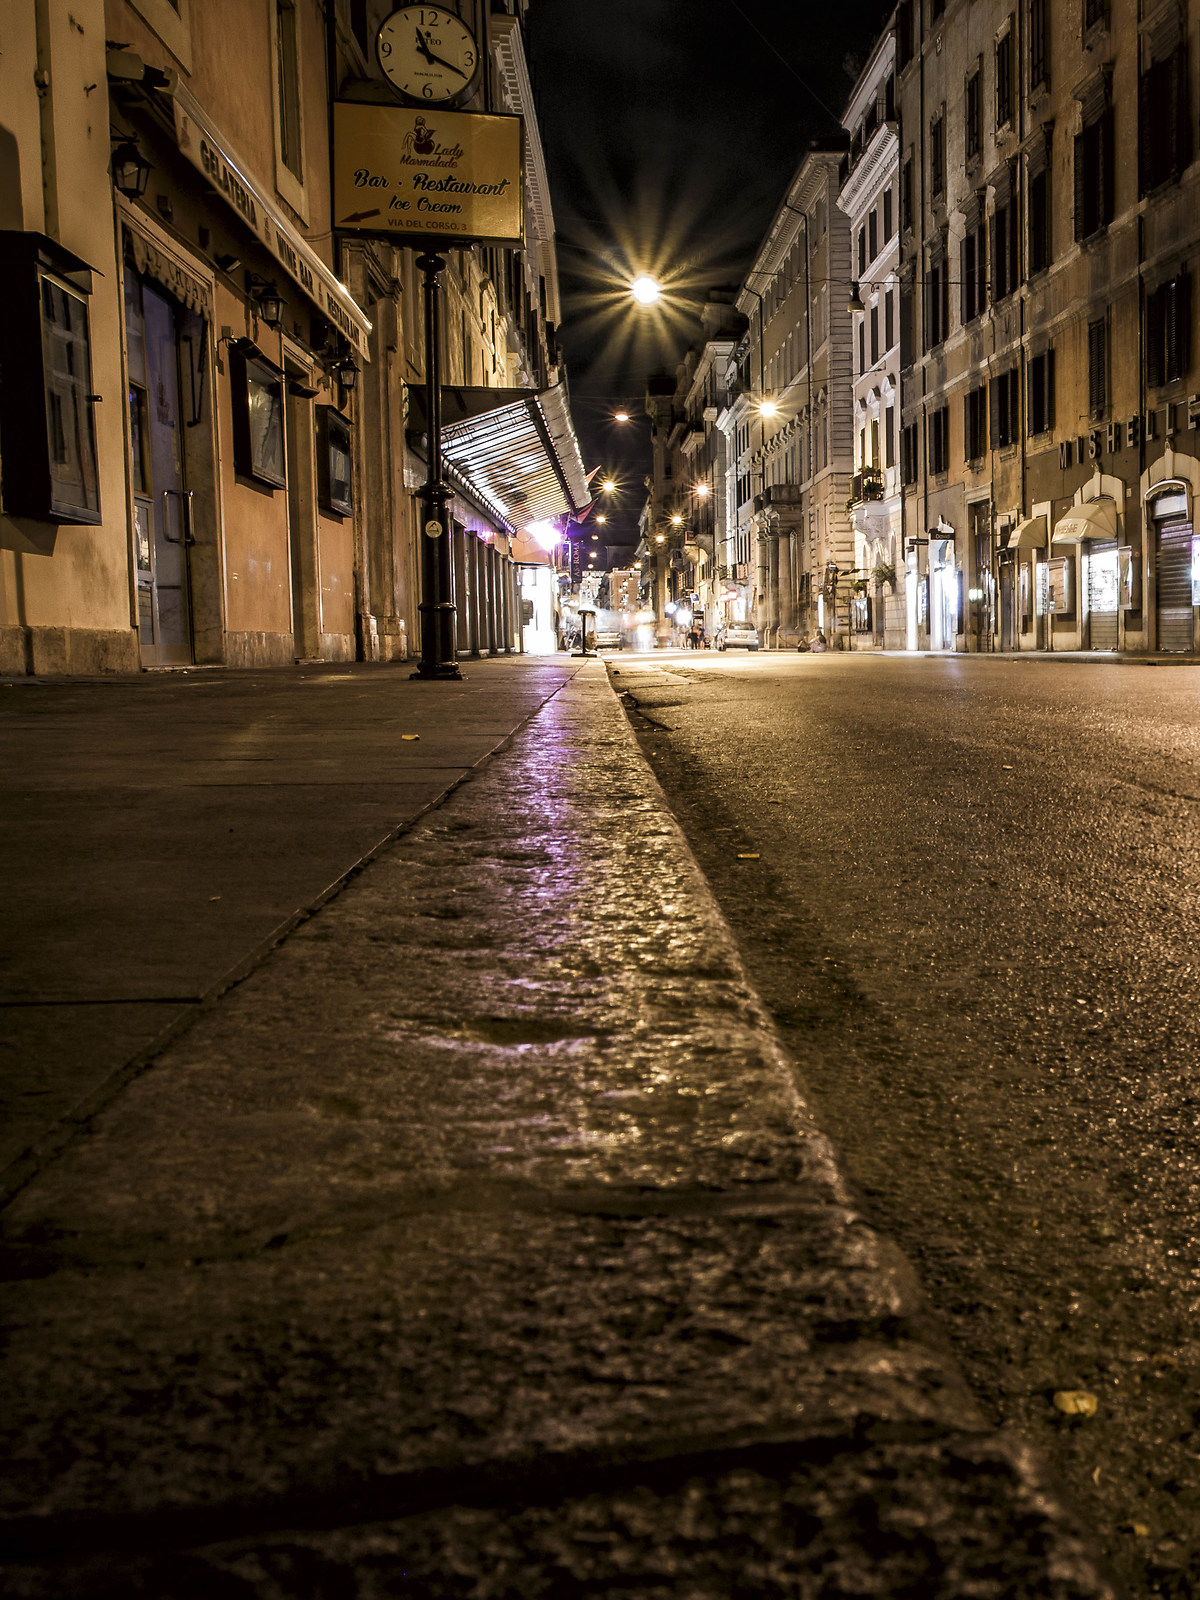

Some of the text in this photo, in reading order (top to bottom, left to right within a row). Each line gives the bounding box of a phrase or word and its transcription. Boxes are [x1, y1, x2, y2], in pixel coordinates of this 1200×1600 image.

[419, 10, 439, 27] 12
[381, 42, 392, 58] 9
[463, 51, 474, 67] 3
[422, 82, 433, 98] 6
[433, 143, 464, 159] Lady
[400, 154, 458, 168] Marmalade
[353, 168, 511, 196] Bar Restaurant
[388, 195, 463, 214] Ice Cream
[200, 139, 257, 231] GELATERIA
[276, 230, 298, 278] WINE
[299, 260, 315, 296] BAR
[388, 218, 403, 227] VIA
[406, 219, 423, 229] DEL
[461, 223, 467, 231] 3
